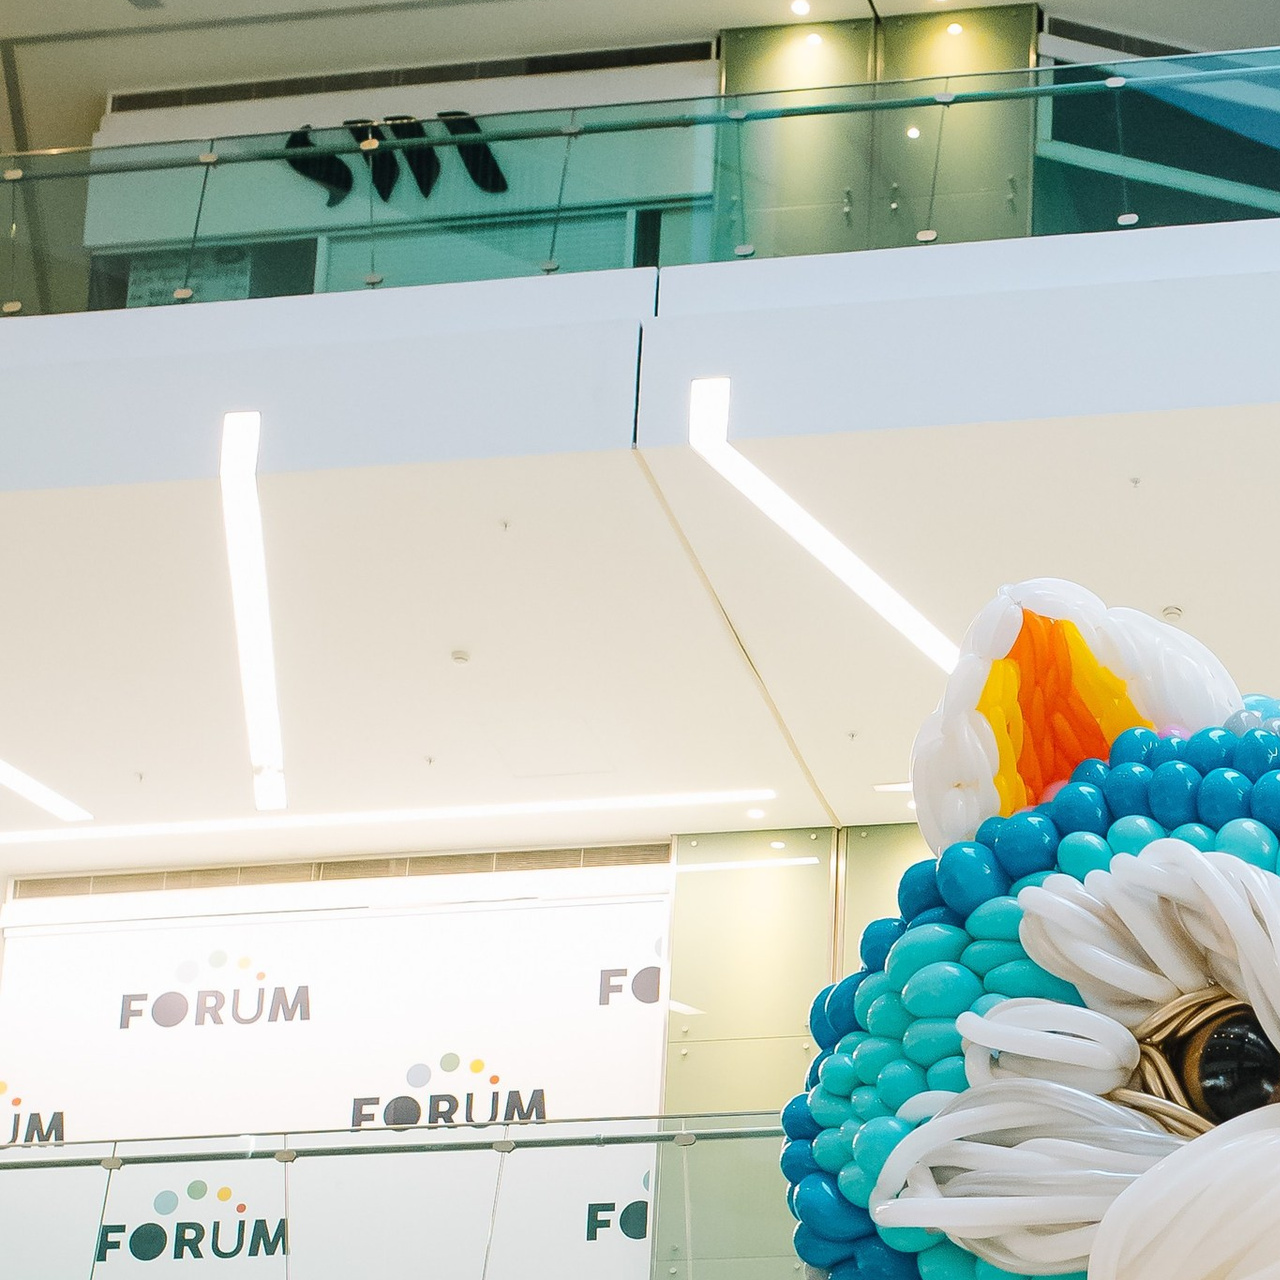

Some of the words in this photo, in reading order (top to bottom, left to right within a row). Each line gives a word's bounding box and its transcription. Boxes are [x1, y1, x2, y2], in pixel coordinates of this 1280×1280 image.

[120, 985, 310, 1029] FORUM
[351, 1089, 547, 1132] FORUM
[96, 1218, 288, 1262] FORUM
